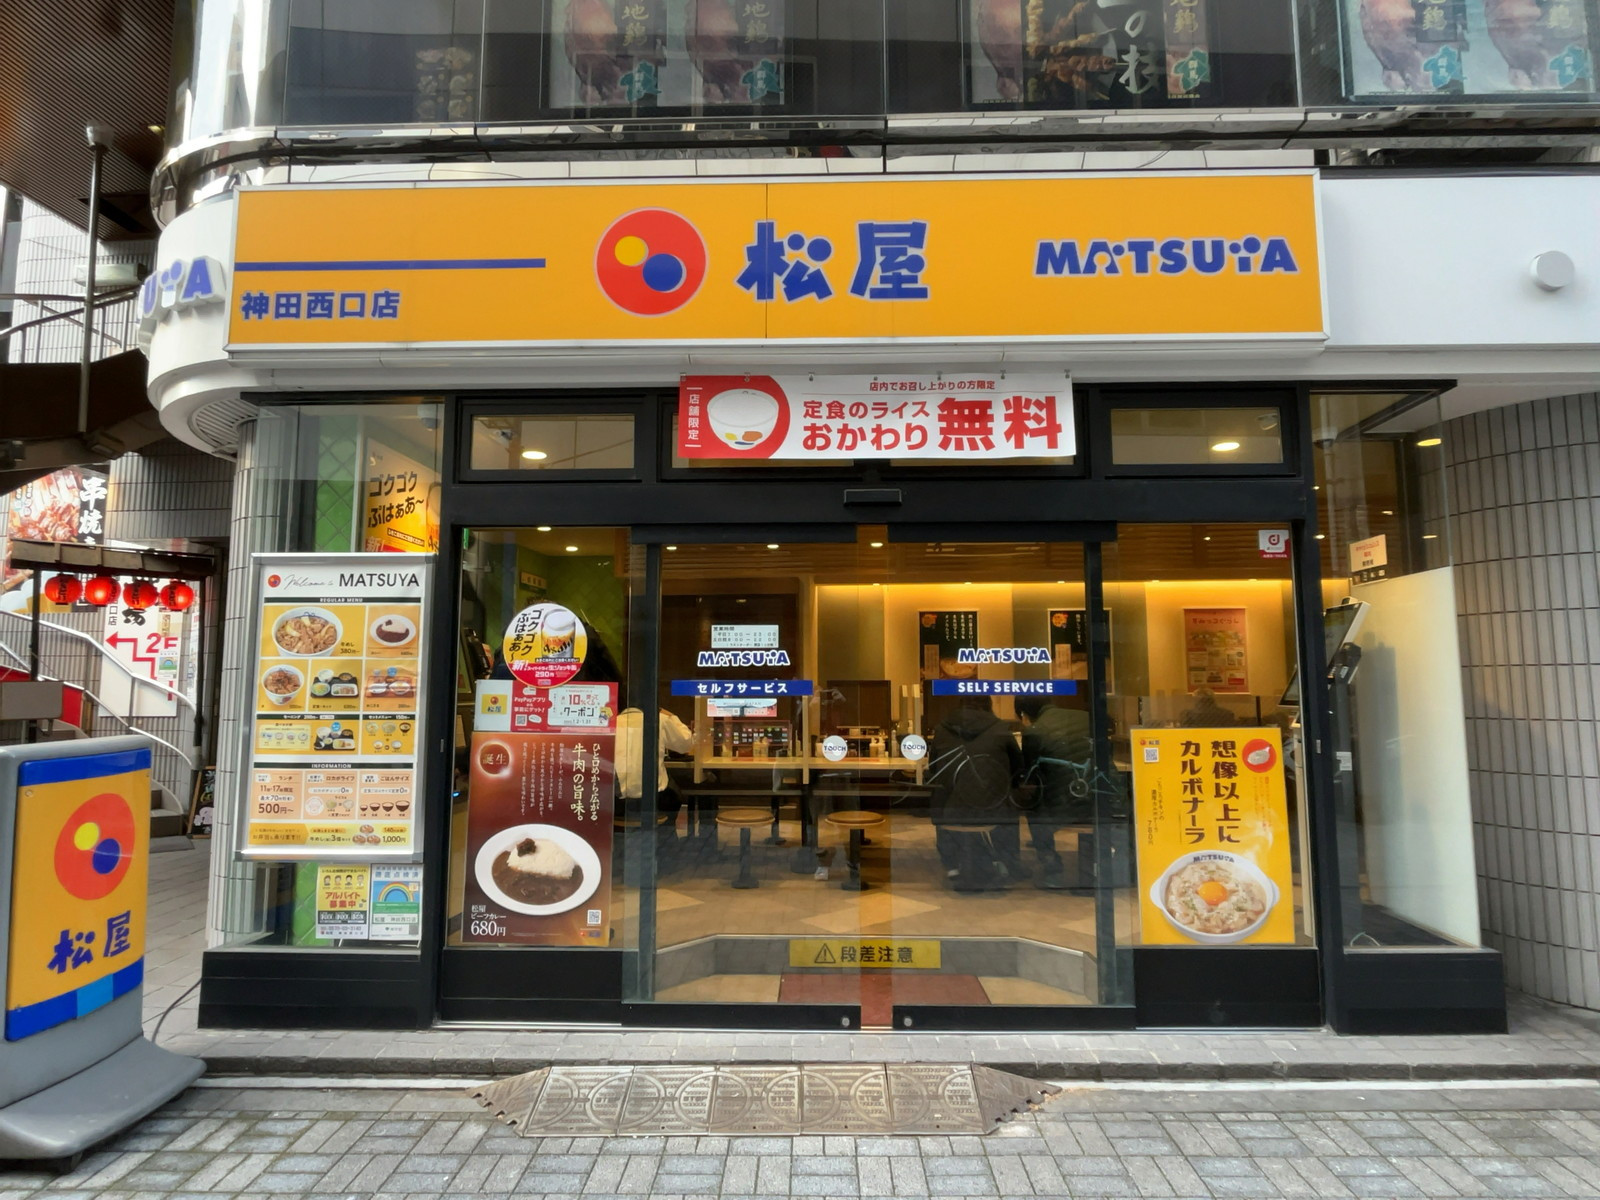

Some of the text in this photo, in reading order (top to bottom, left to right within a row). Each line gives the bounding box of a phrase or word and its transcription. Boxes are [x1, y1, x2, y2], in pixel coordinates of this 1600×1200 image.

[736, 220, 930, 303] 松屋
[1035, 235, 1299, 277] MATSUYA
[241, 290, 401, 321] 神田西口店
[869, 379, 996, 392] 店内でお召し上がりの方限定
[802, 399, 931, 420] 定食のライス
[937, 394, 1063, 452] 無料
[802, 422, 929, 452] おかわり
[369, 471, 418, 497] ゴクゴク
[339, 572, 420, 588] MATSUYA
[519, 607, 544, 656] ゴクゴク
[697, 649, 790, 667] MATSUYA
[957, 646, 1052, 664] MATSUYA
[697, 682, 788, 694] セルフサービス
[957, 682, 1054, 693] SELF SERVICE
[563, 706, 596, 717] クーポン
[824, 744, 847, 752] TOUCH
[902, 743, 926, 751] TOUCH
[482, 753, 507, 766] 誕生
[570, 742, 588, 822] 牛肉の旨味。
[590, 742, 602, 822] ひと口めから広がる
[1210, 740, 1241, 844] 想像以上に
[1180, 740, 1206, 845] カルボナーラ
[325, 891, 361, 899] アルバイト
[470, 920, 507, 937] 680円
[47, 909, 132, 975] 松屋
[840, 945, 914, 964] 段差注意
